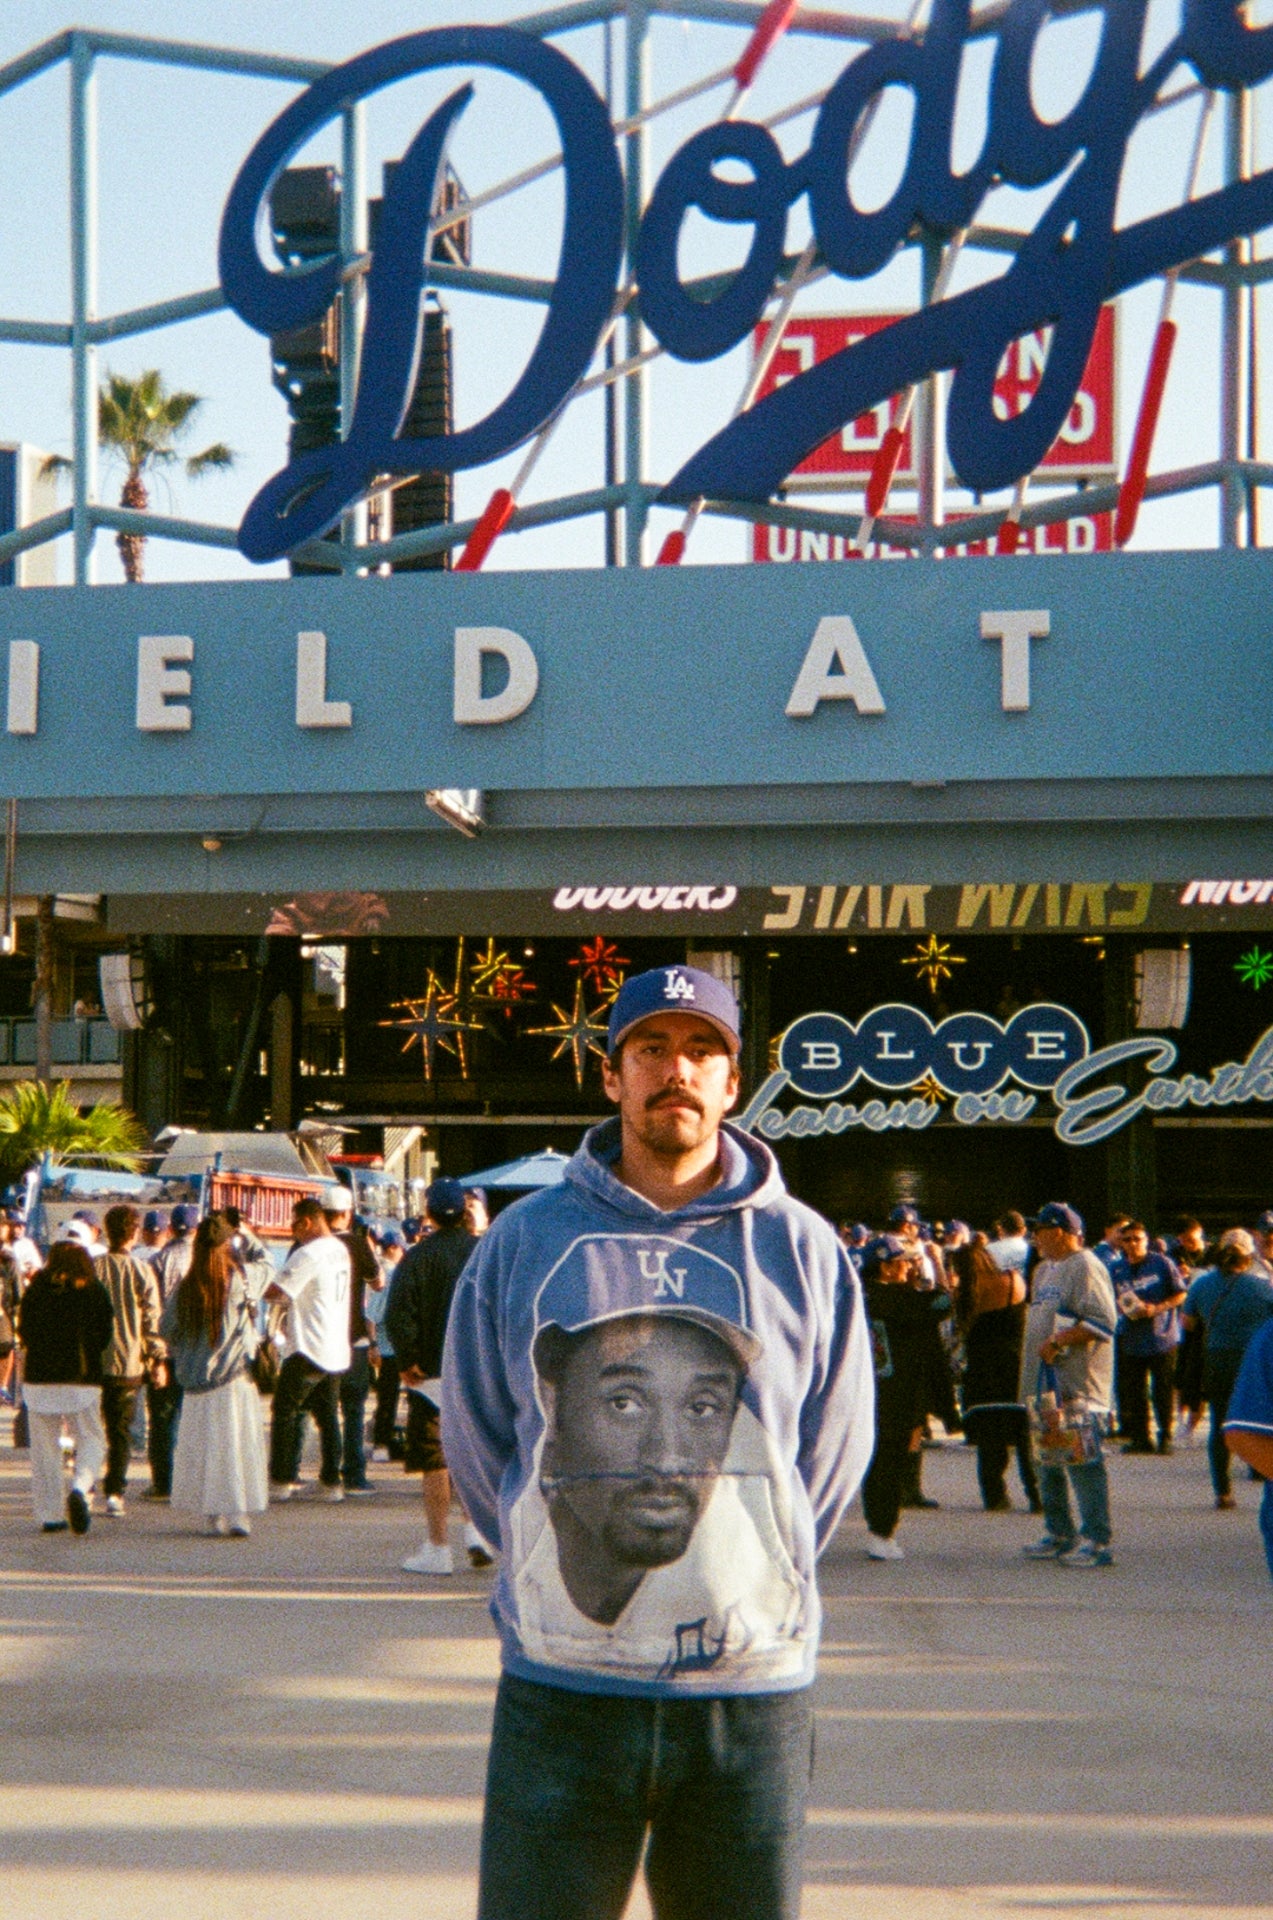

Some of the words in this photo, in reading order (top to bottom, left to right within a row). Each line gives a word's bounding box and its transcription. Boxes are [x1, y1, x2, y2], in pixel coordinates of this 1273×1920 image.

[784, 610, 1051, 718] AT
[664, 969, 695, 1000] LA
[801, 1031, 1067, 1071] BLUE
[954, 1092, 1036, 1125] on
[637, 1250, 688, 1298] UN
